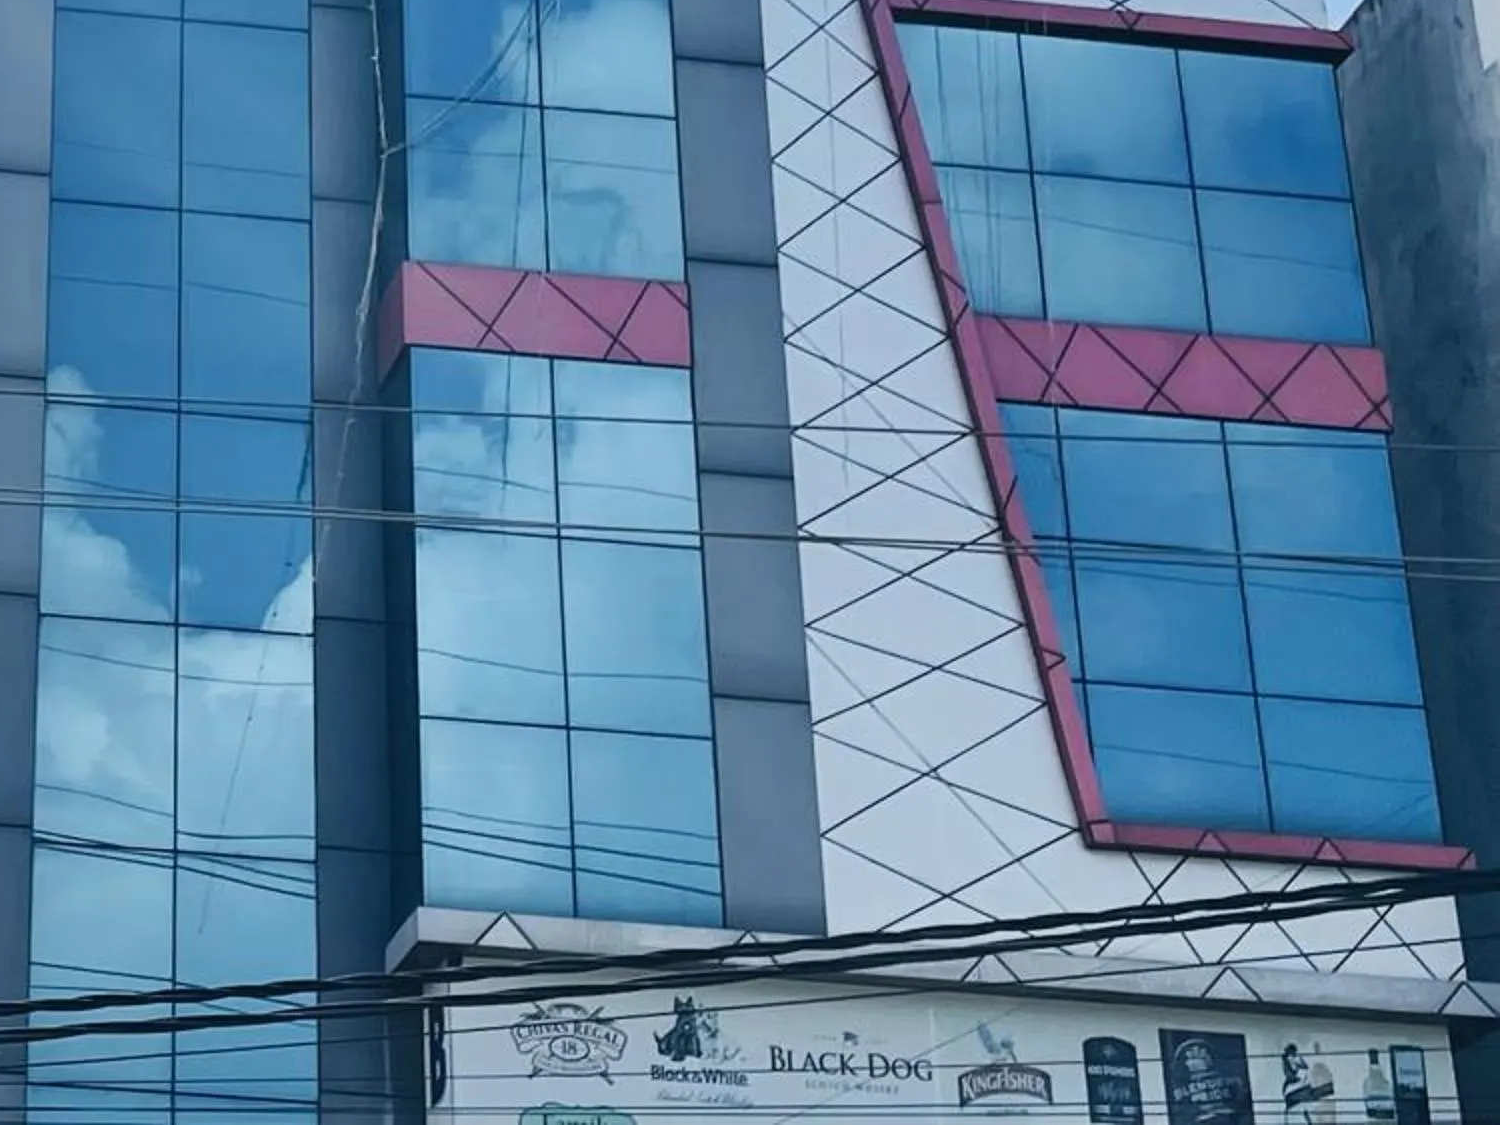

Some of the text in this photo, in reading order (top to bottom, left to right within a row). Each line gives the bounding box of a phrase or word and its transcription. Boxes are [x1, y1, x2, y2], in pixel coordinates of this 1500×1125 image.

[516, 1022, 620, 1046] CHIVAS REGAL
[770, 1044, 857, 1077] BLACK
[868, 1052, 933, 1082] DOG
[962, 1067, 1048, 1100] KINGFISHER
